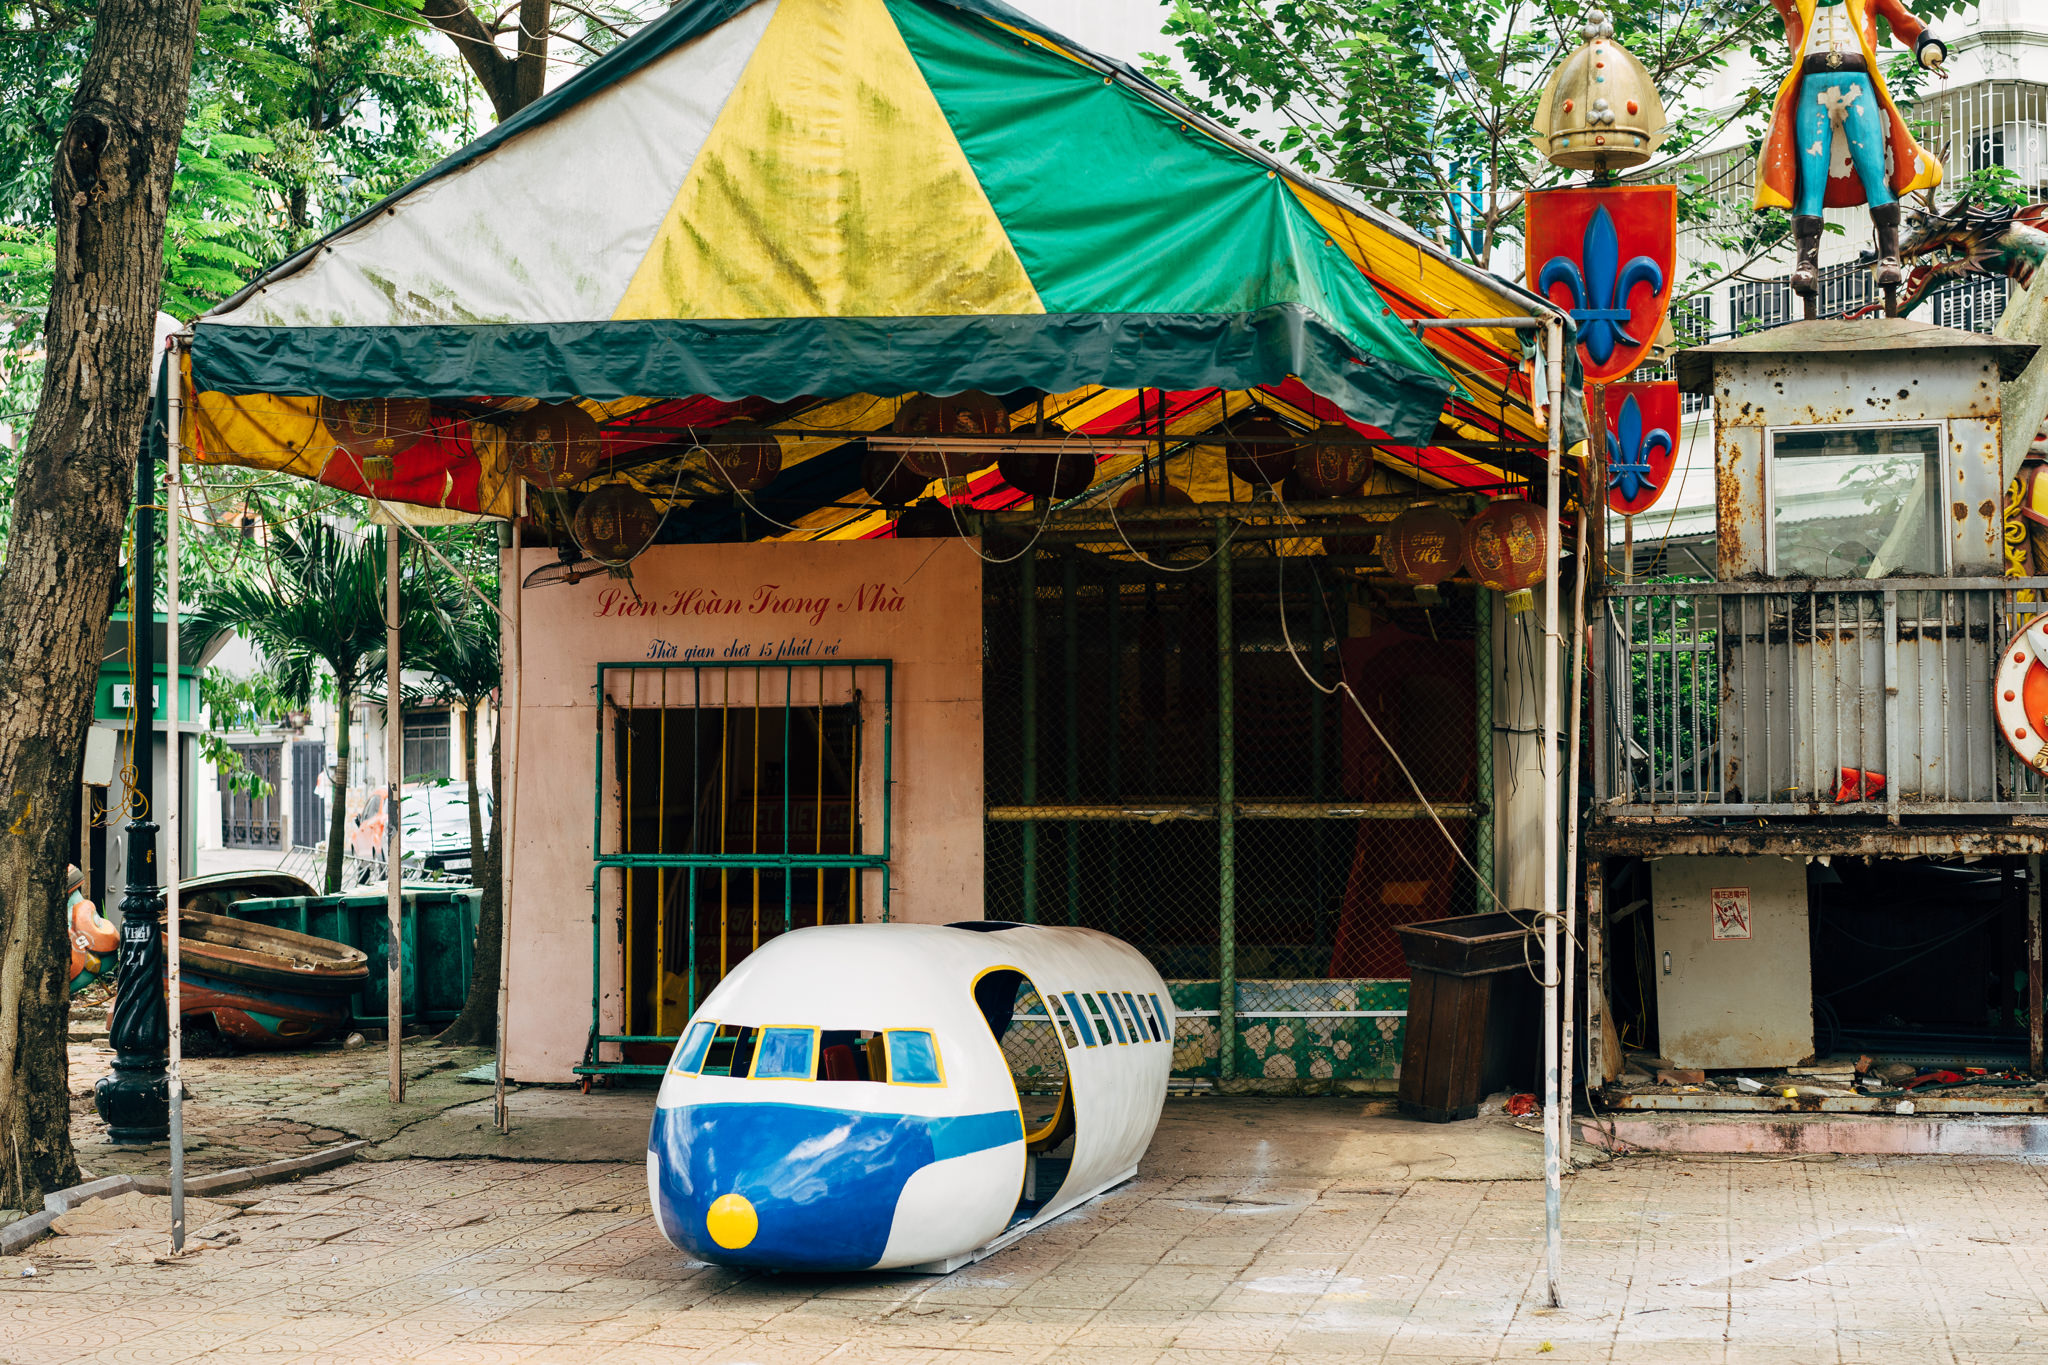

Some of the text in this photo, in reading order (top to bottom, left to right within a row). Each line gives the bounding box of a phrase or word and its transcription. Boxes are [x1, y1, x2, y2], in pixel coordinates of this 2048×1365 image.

[593, 583, 905, 626] Liên Hoàn Trong Nhà
[684, 644, 715, 661] gian
[759, 643, 773, 657] 15
[775, 637, 813, 660] phút
